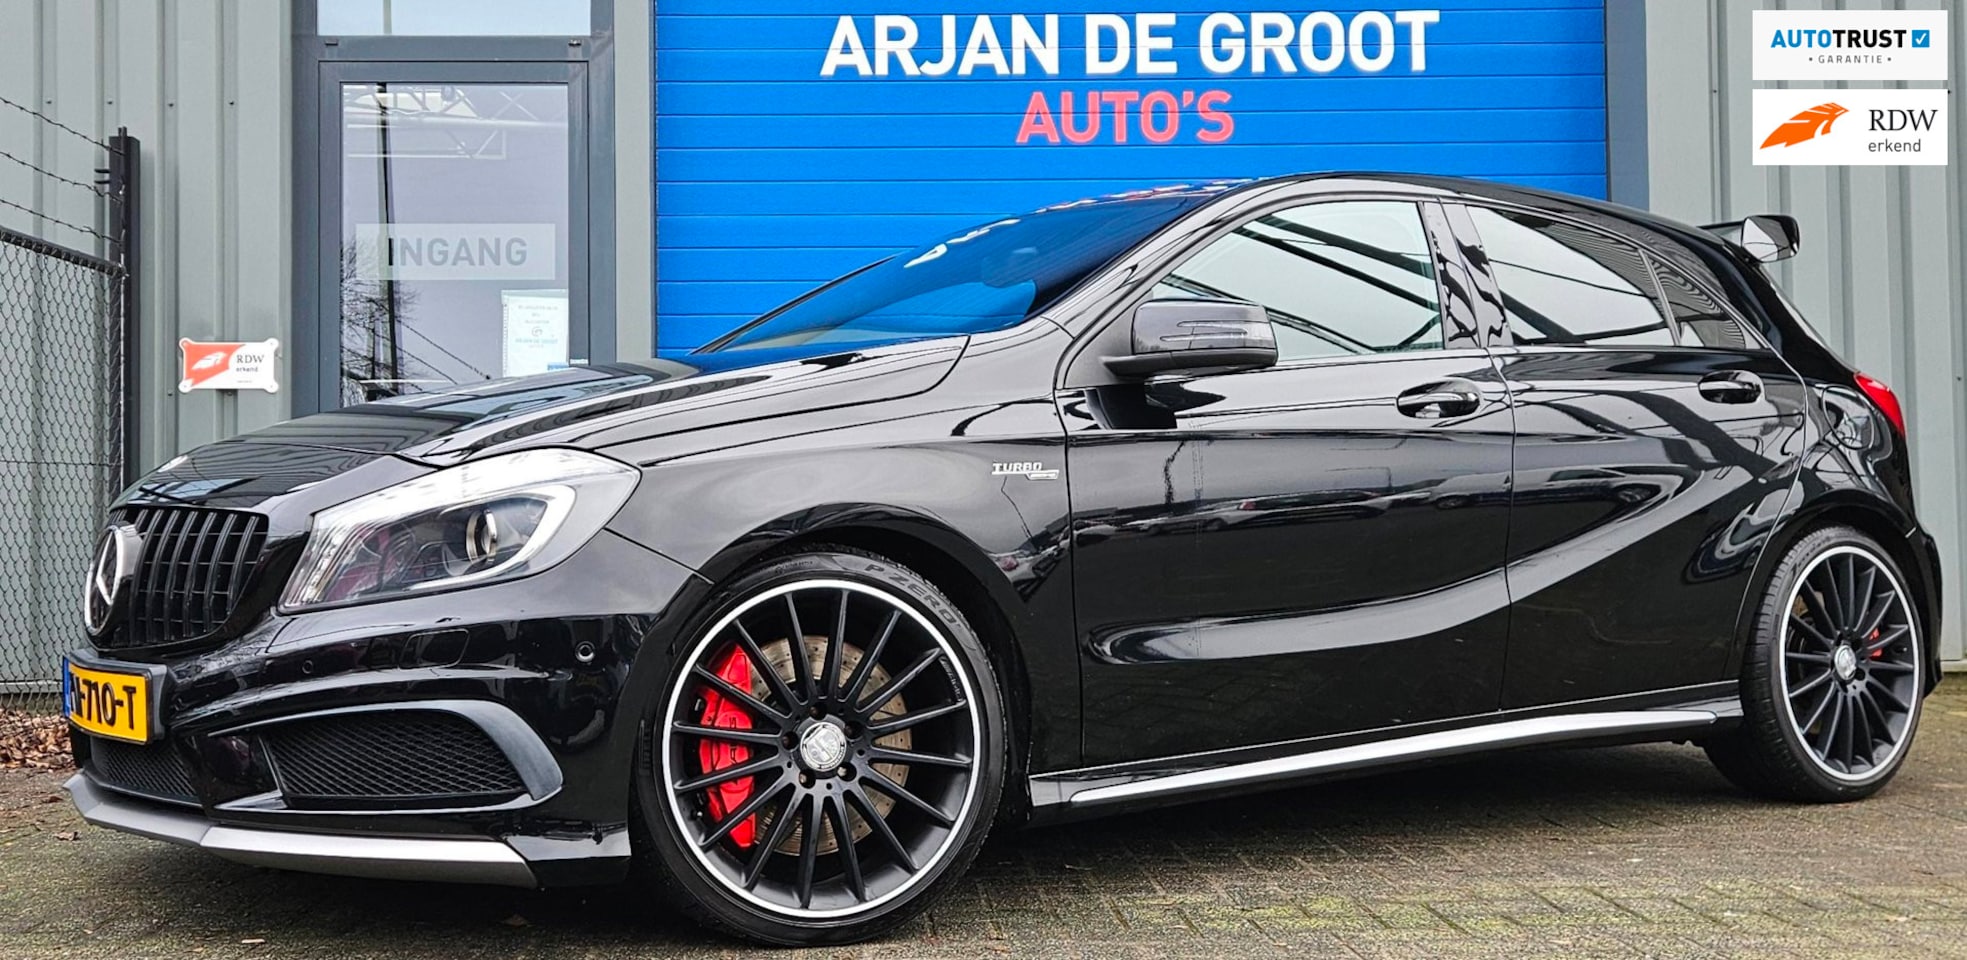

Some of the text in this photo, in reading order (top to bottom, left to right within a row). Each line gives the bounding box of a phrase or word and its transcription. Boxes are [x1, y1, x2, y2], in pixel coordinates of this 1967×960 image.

[820, 10, 1440, 76] ARJAN DE GROOT
[1016, 90, 1234, 144] AUTO'S
[388, 237, 528, 267] INGANG
[236, 354, 265, 364] RDW
[992, 462, 1043, 473] TURBO
[864, 564, 957, 624] P ZERO
